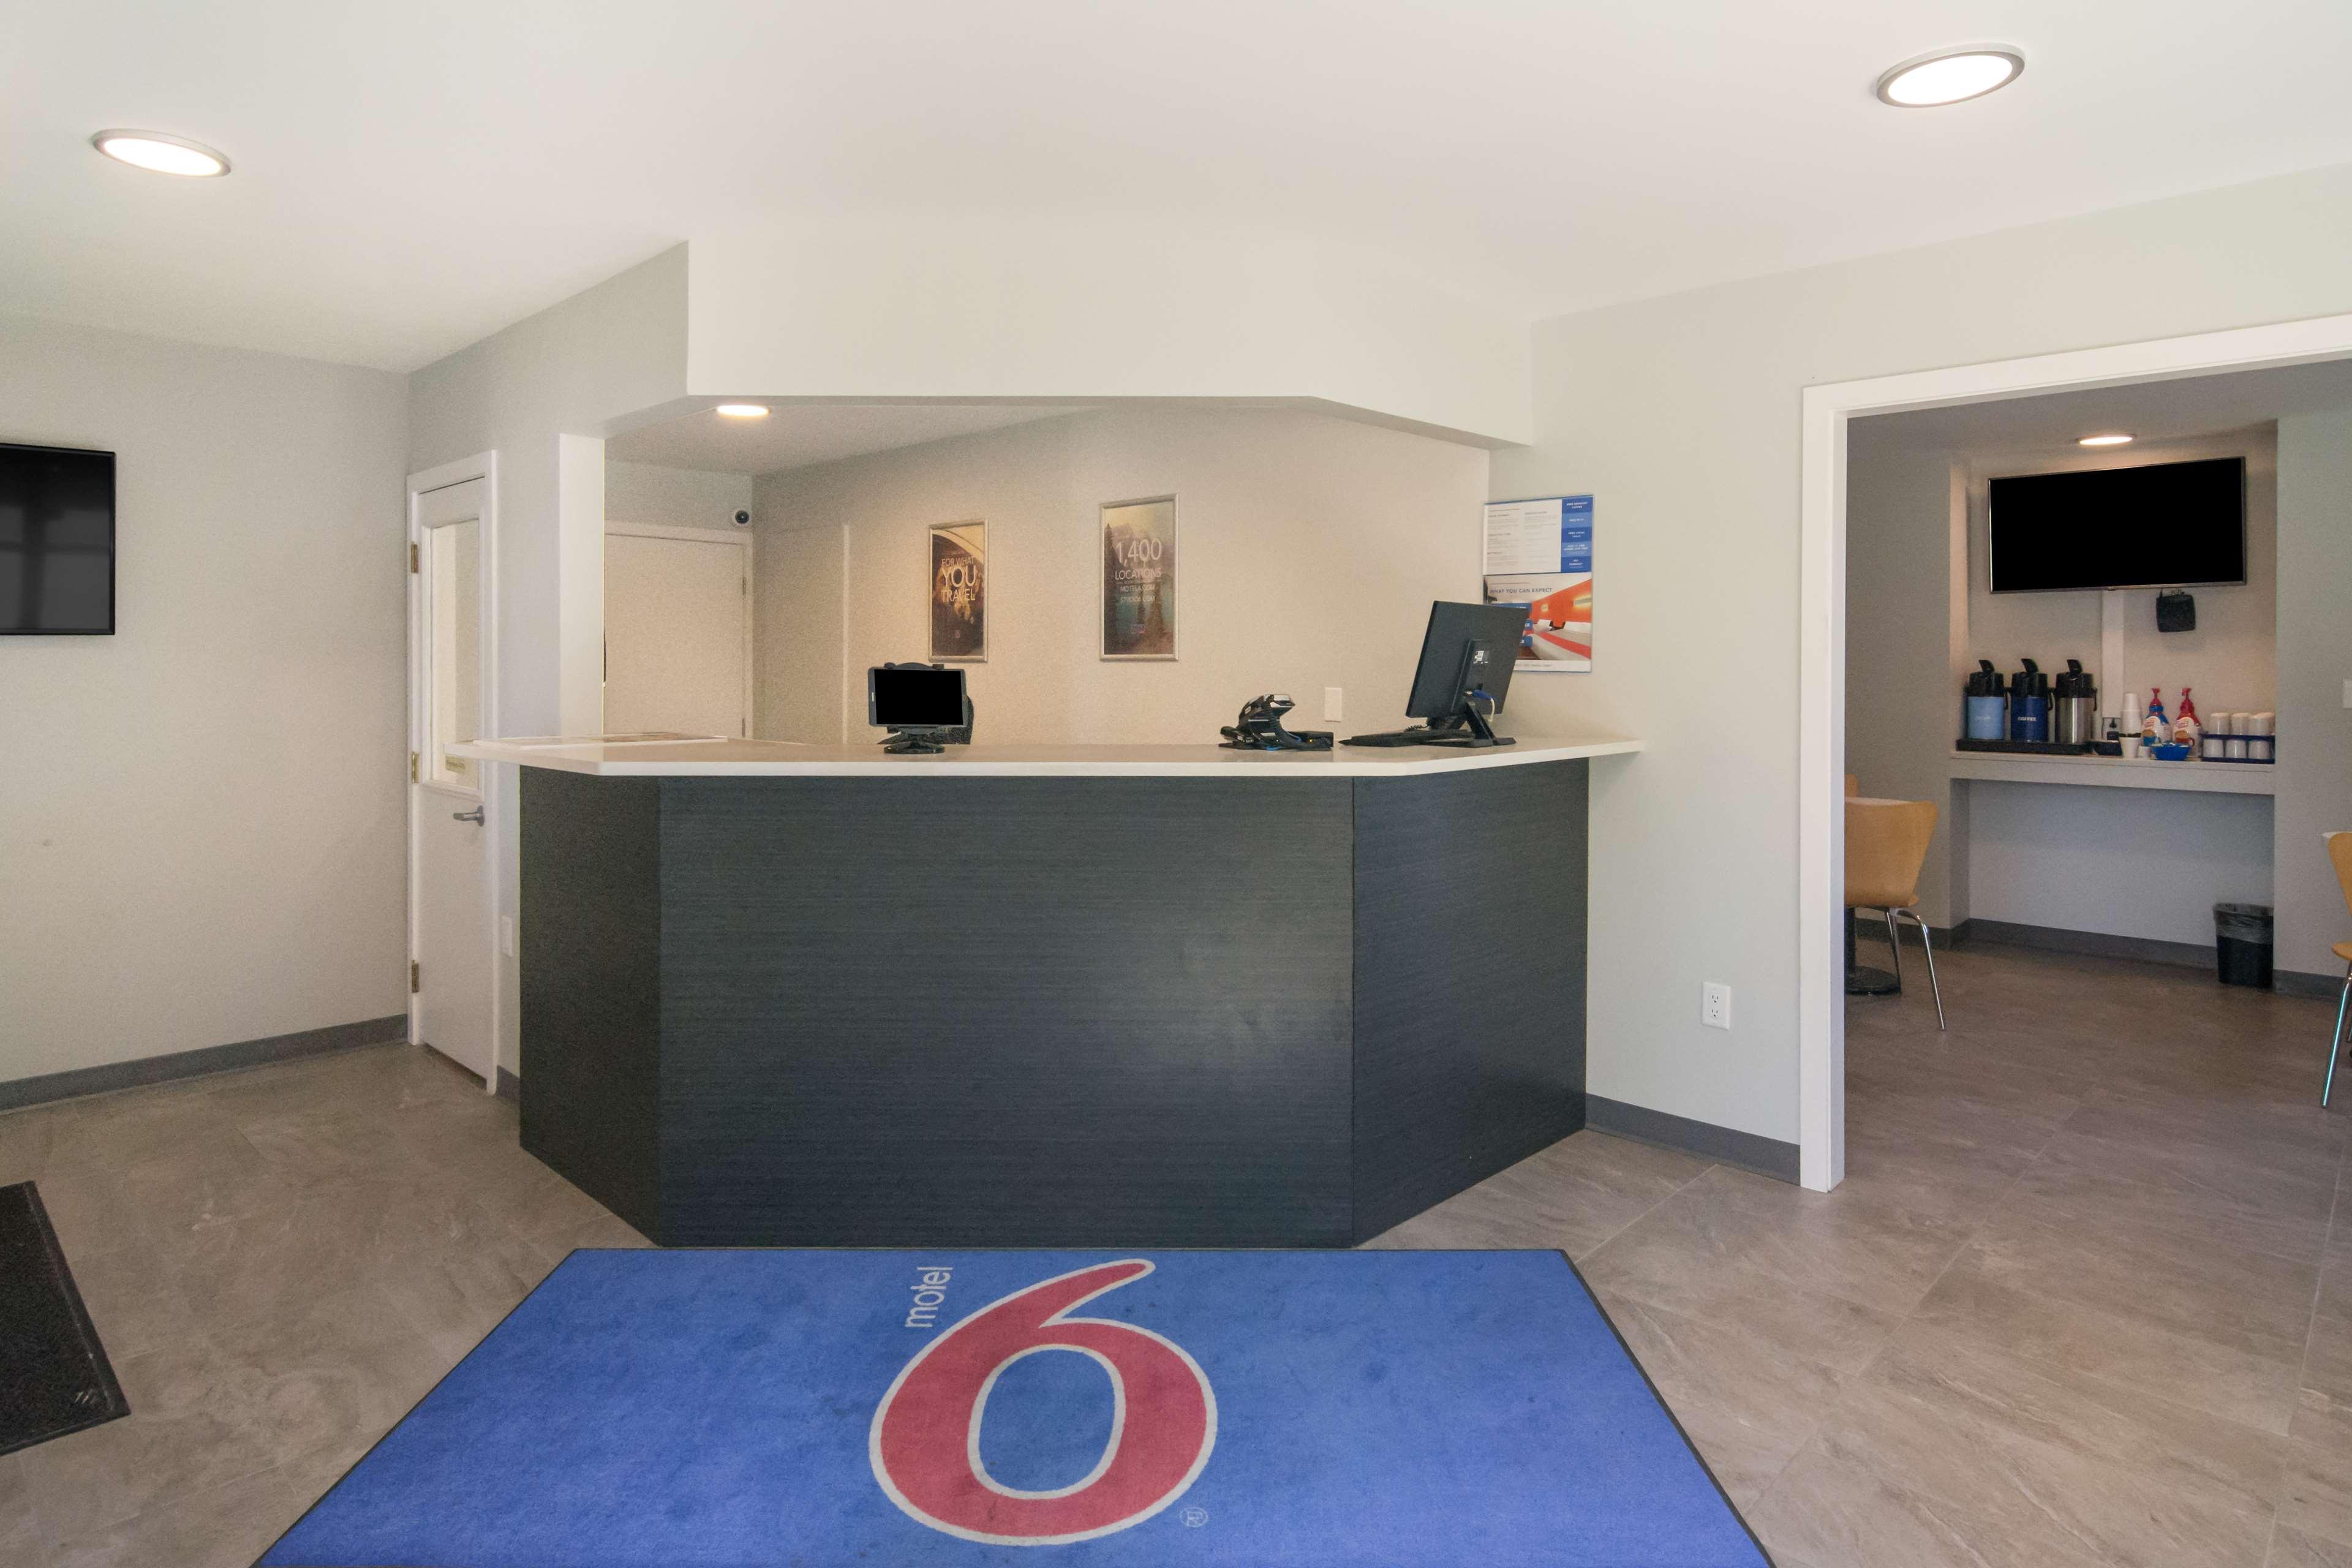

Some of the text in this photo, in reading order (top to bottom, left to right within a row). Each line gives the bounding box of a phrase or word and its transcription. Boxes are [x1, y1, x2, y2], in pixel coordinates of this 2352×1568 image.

[941, 556, 975, 567] FOR WHAT
[1116, 538, 1162, 567] 1,400
[941, 564, 976, 587] YOU
[1115, 567, 1162, 580] LOCATIONS
[941, 588, 976, 603] TRAVEL
[905, 1266, 954, 1328] motel
[868, 1258, 1218, 1547] 6
